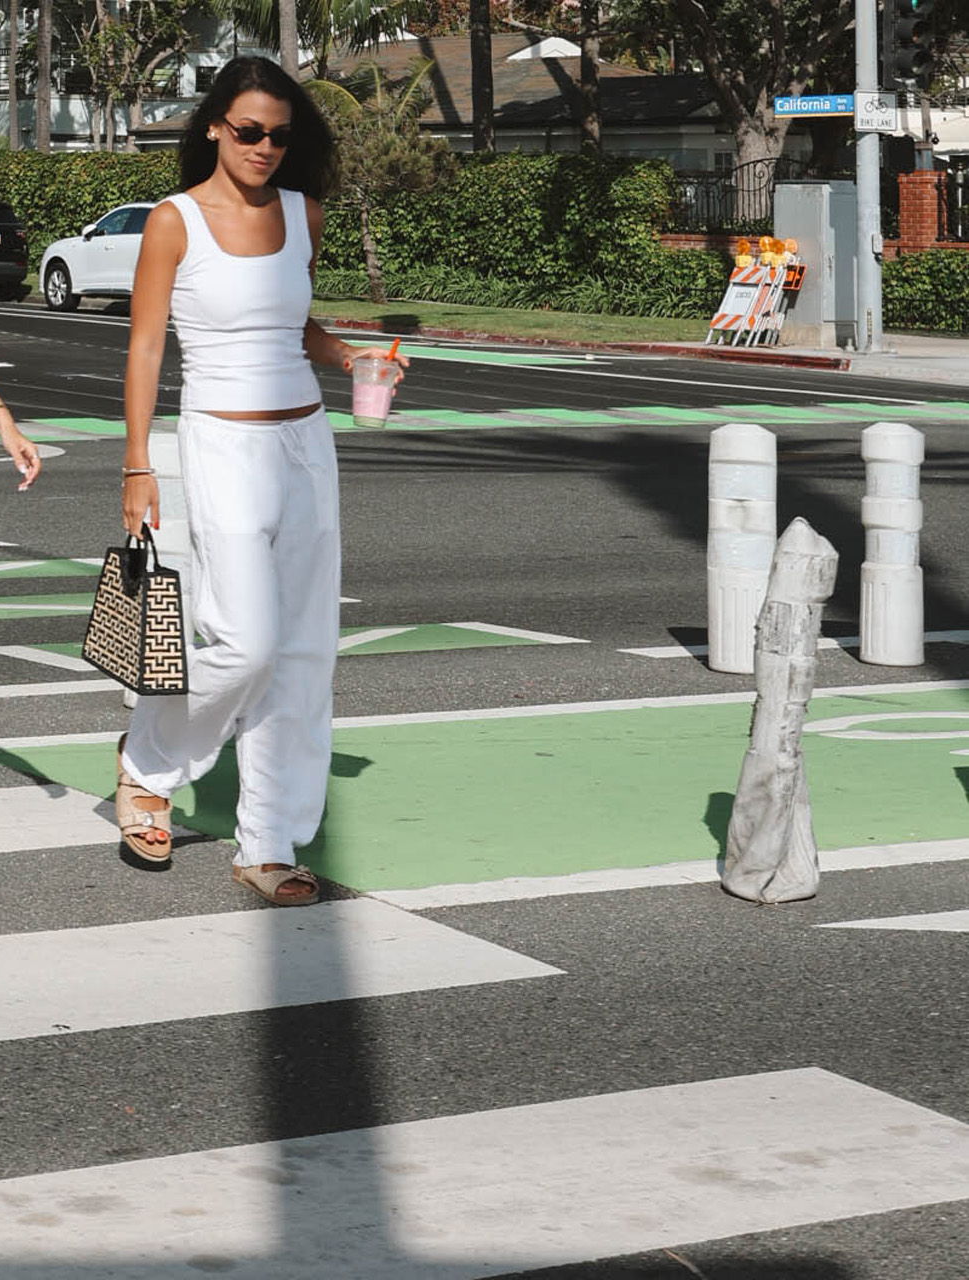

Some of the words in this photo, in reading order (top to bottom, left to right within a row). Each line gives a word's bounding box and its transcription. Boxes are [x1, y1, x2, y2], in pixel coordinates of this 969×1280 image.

[776, 98, 830, 111] California
[860, 119, 874, 127] BIKE
[877, 119, 892, 127] LANE
